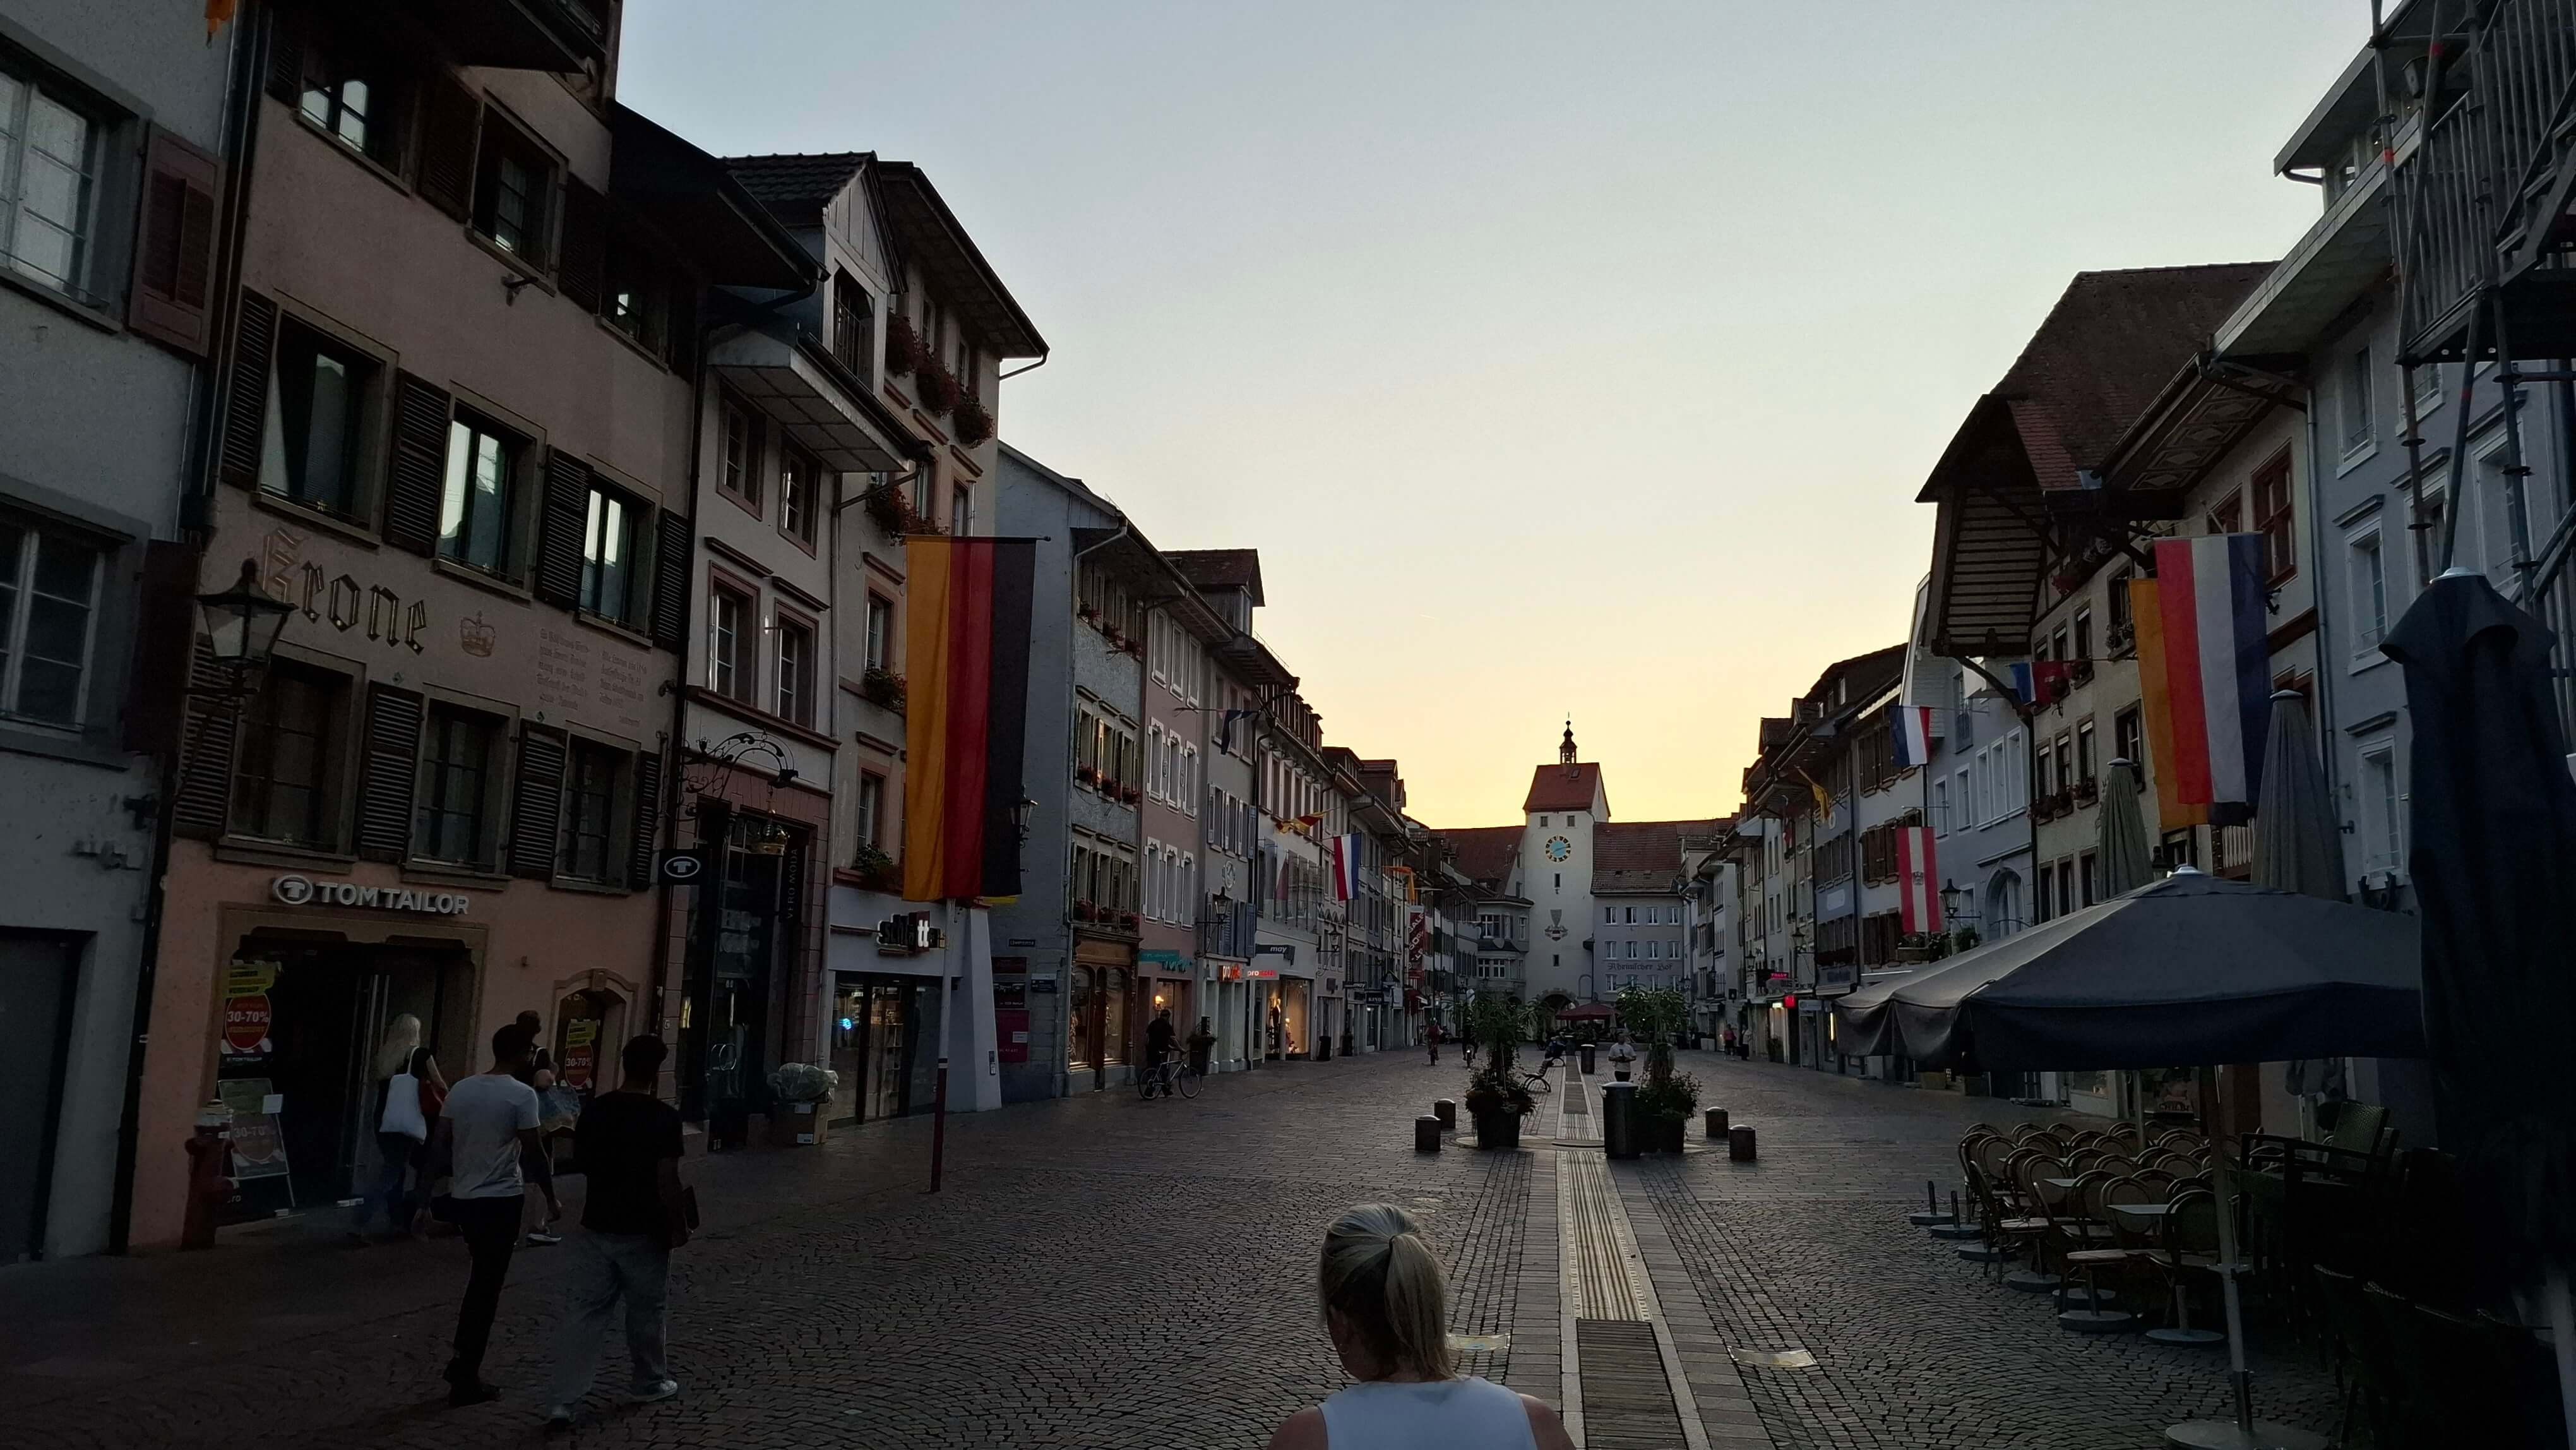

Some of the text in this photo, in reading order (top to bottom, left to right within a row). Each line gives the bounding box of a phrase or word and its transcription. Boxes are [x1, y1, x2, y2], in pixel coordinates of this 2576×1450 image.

[787, 848, 799, 920] VERO MODA
[381, 889, 470, 915] TAILOR
[227, 1010, 269, 1023] 30-70%
[565, 1057, 592, 1067] 30-70%
